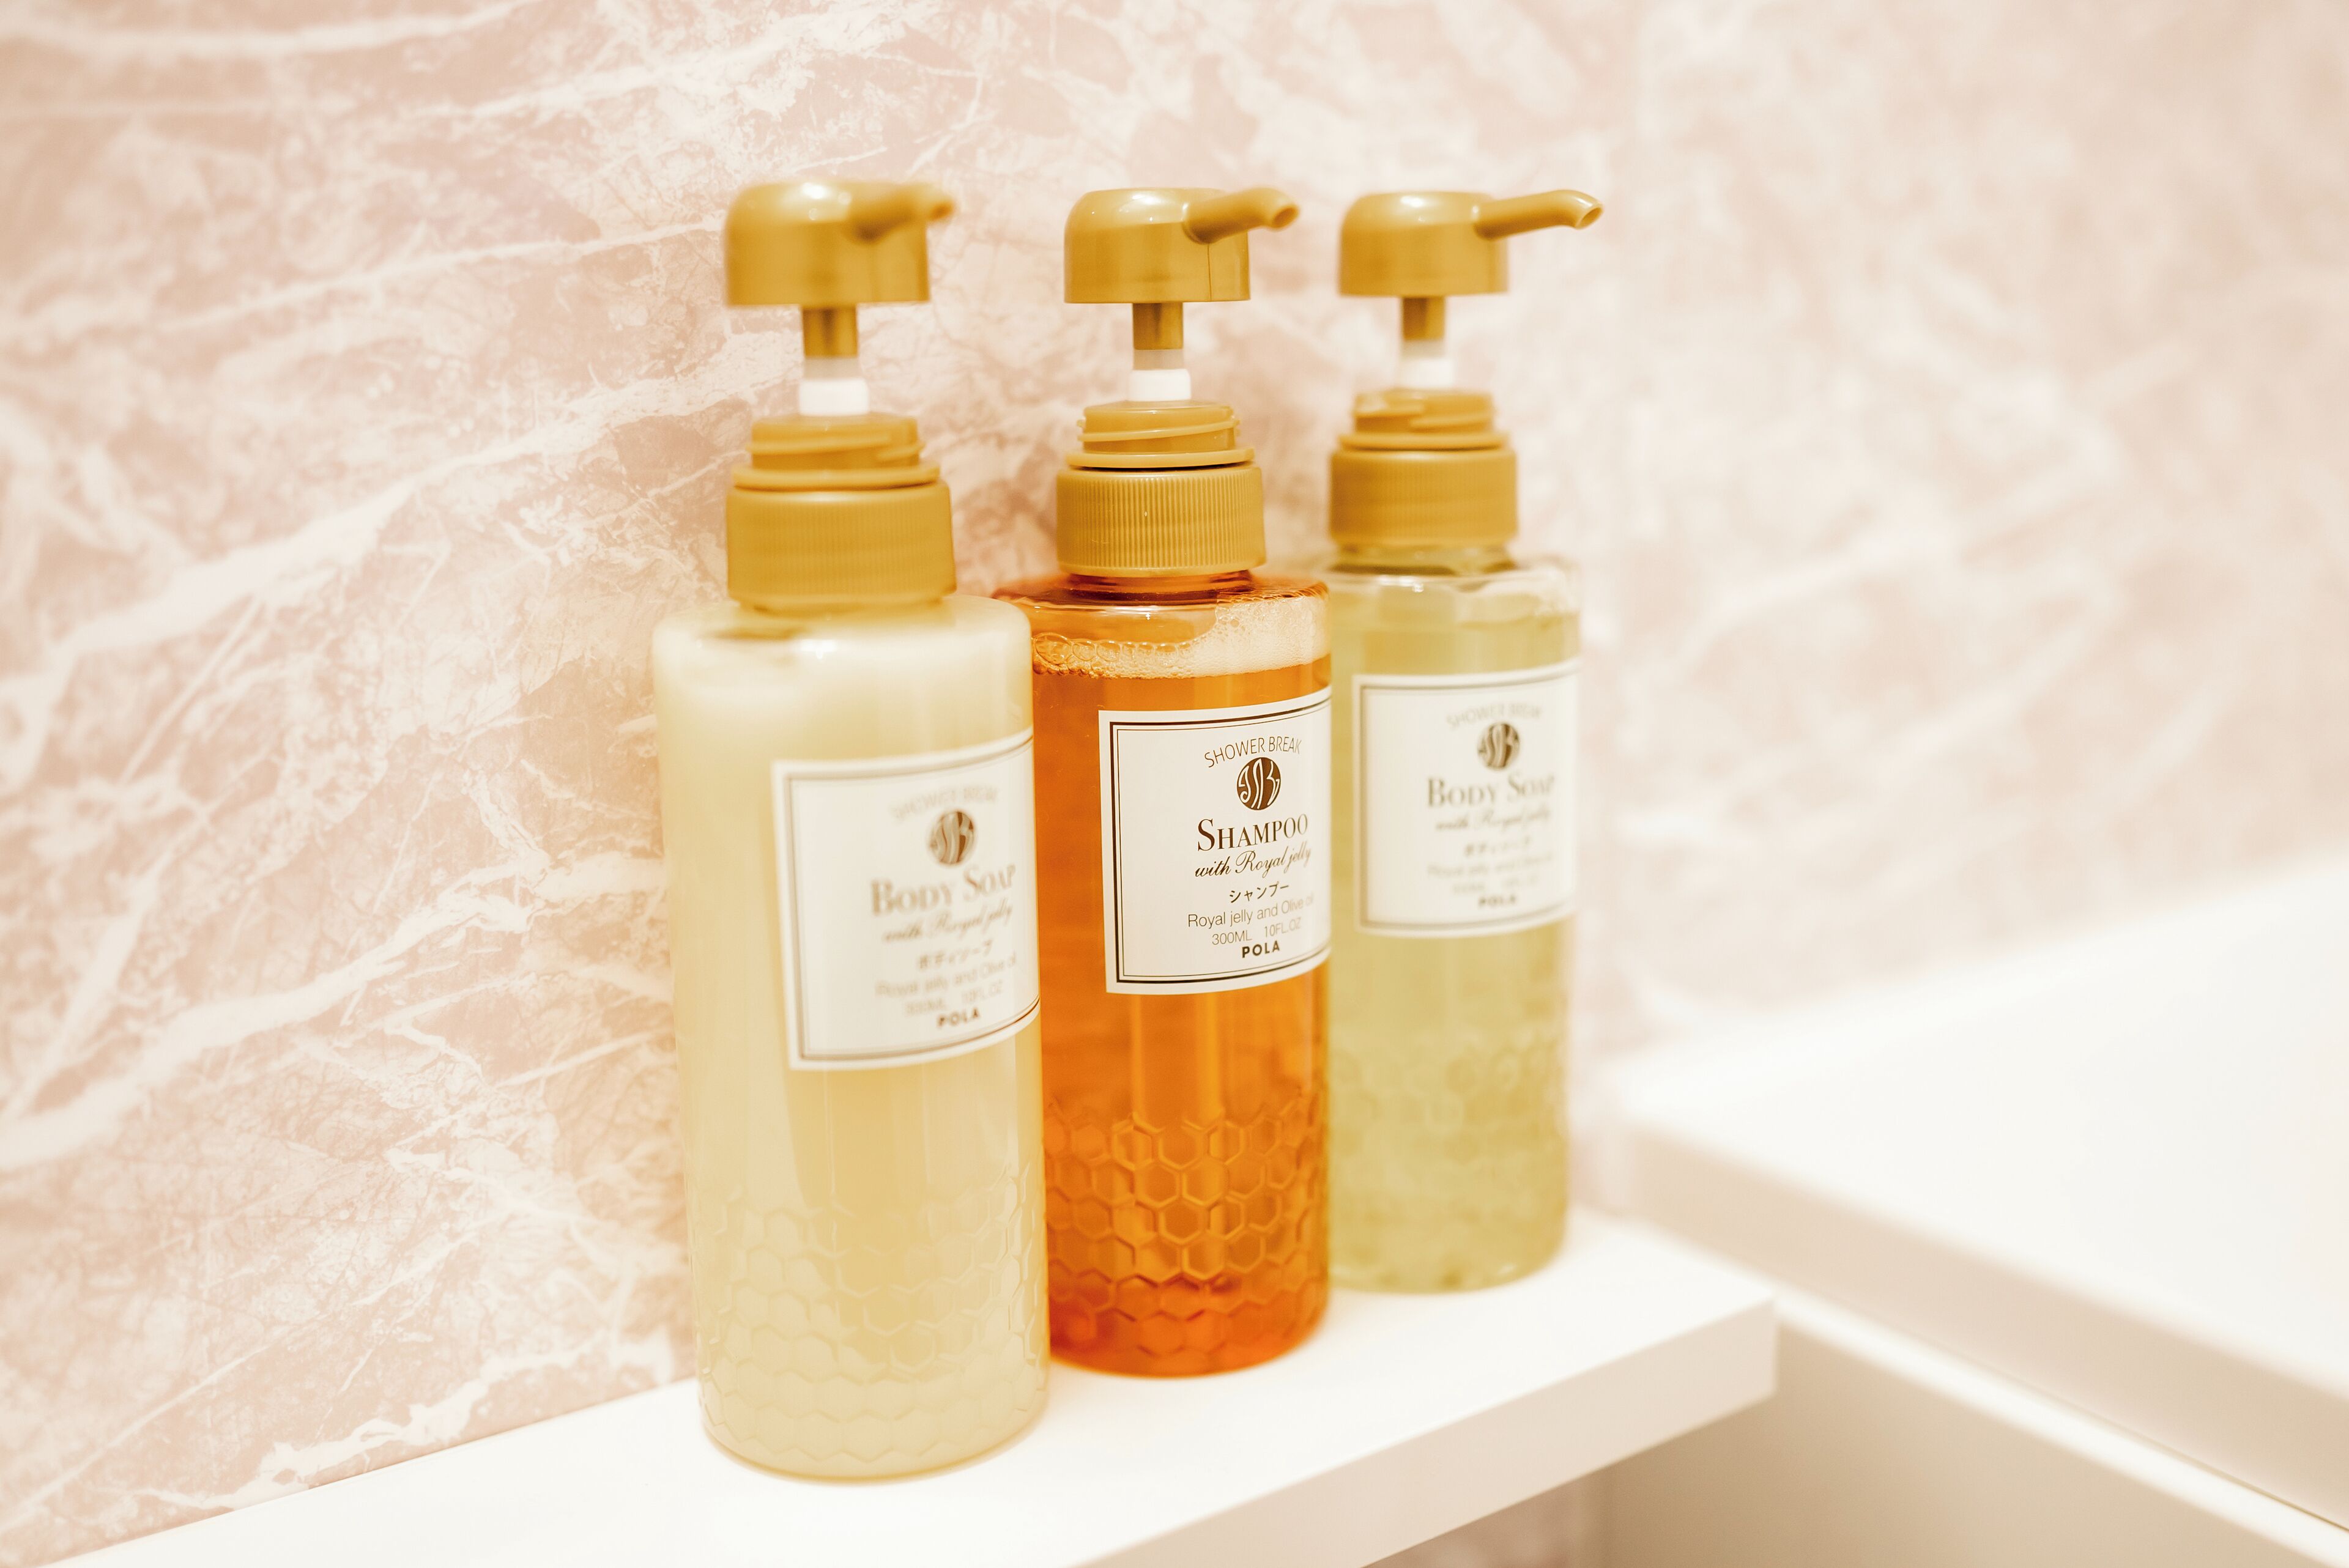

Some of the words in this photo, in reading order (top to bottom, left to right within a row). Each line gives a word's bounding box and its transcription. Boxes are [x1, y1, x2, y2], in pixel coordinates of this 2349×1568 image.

[1204, 738, 1266, 768] SHOWER
[1269, 736, 1302, 754] BREAK
[1197, 814, 1308, 851] SHAMPOO
[1195, 856, 1231, 877] with
[1235, 846, 1289, 878] Royal
[1283, 841, 1312, 874] jelly
[1229, 881, 1290, 903] シャンプー
[1188, 911, 1226, 929] Royal
[1230, 909, 1253, 926] jelly
[1256, 903, 1278, 920] and
[1281, 897, 1304, 914] Olive
[1212, 930, 1253, 945] 300ML
[1242, 940, 1280, 958] POLA
[937, 1008, 980, 1027] POLA
